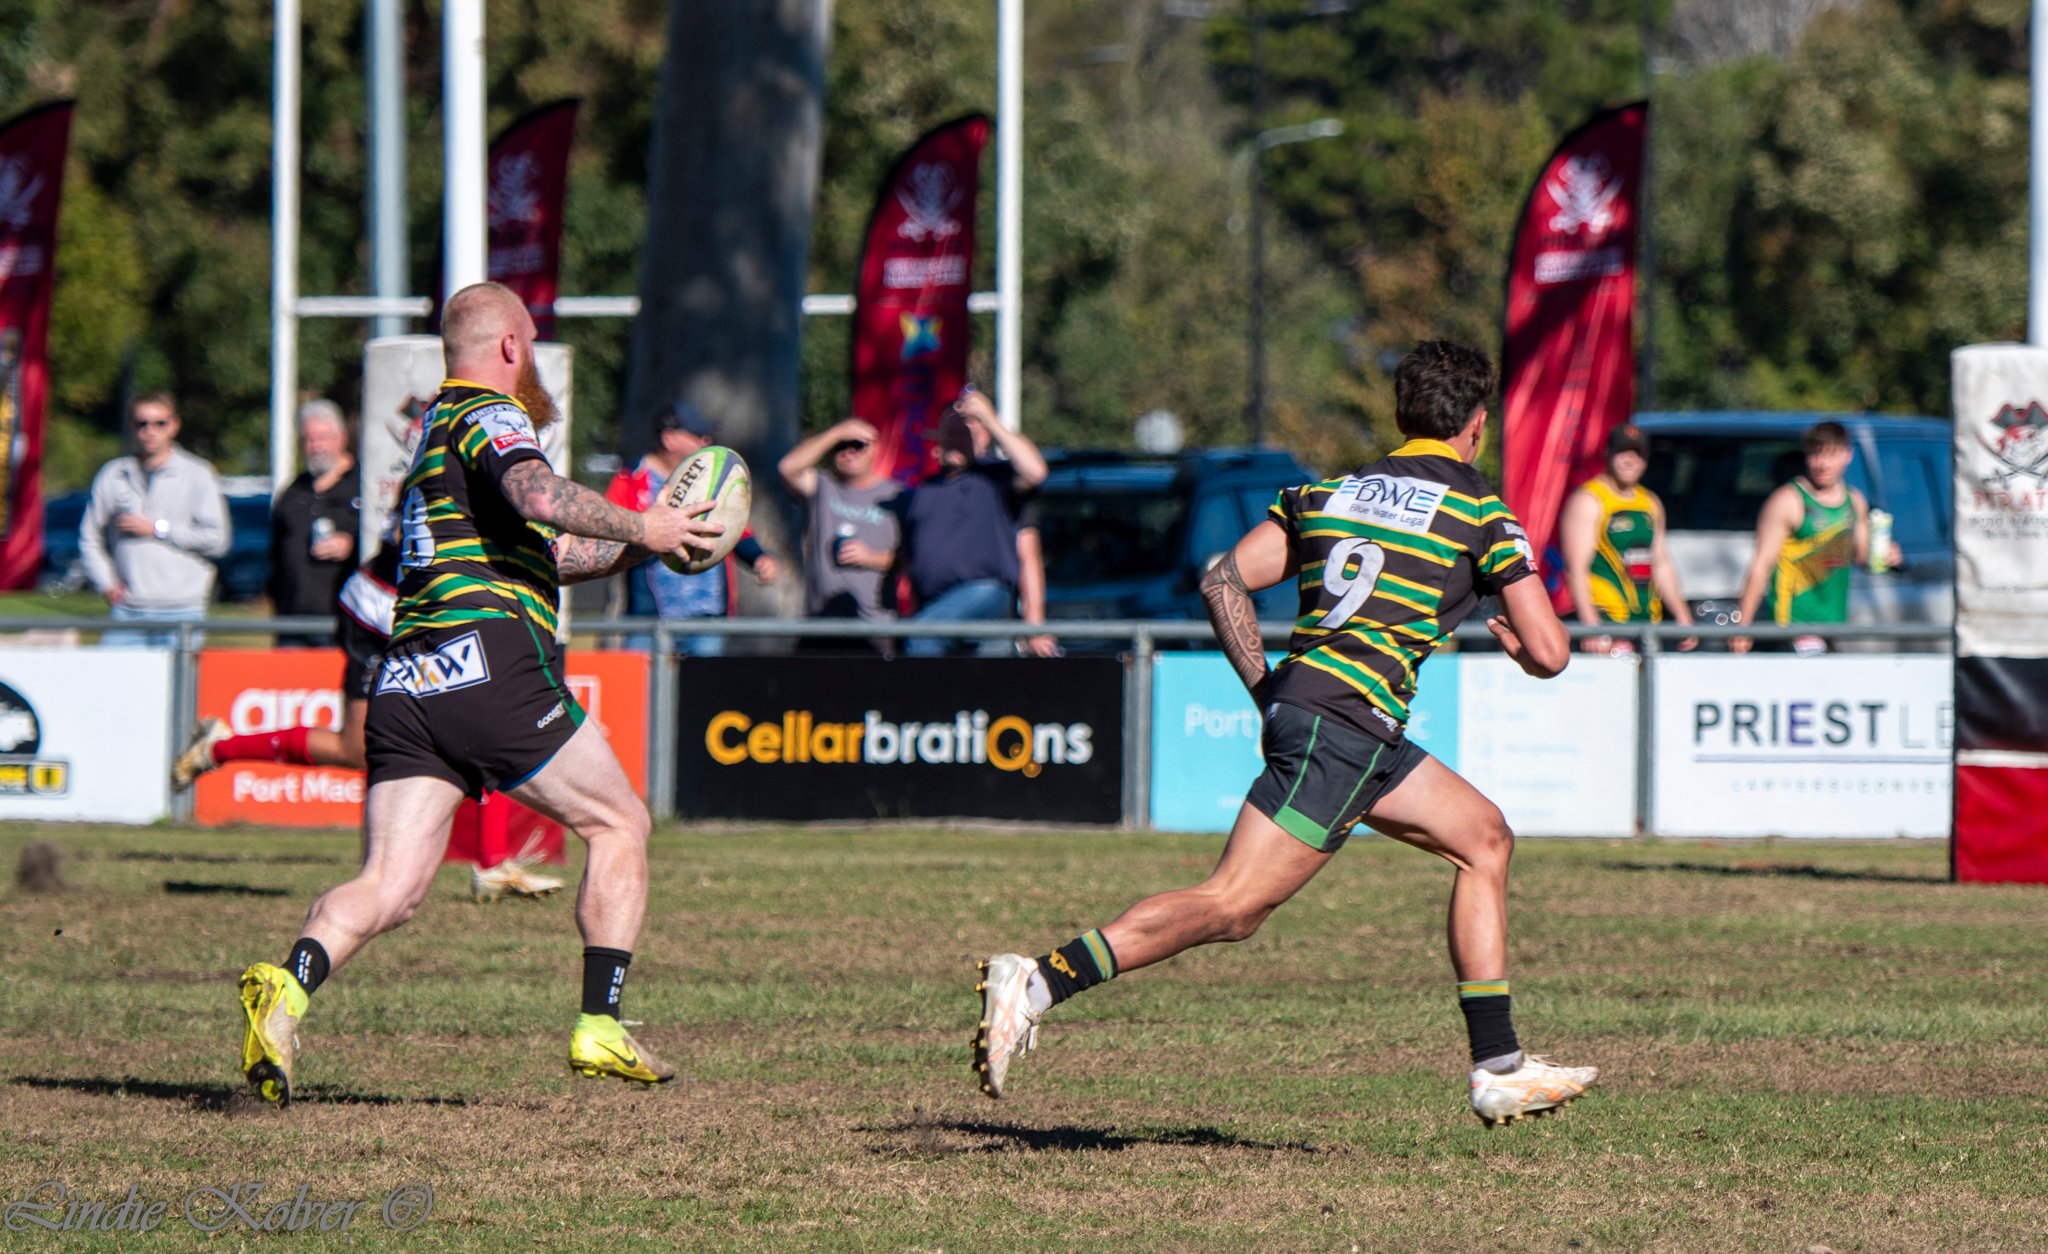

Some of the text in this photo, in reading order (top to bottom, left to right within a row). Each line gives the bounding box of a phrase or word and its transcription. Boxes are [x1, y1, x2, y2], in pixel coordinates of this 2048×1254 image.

[1350, 502, 1426, 527] Blue Water Legal
[1316, 537, 1385, 629] 9
[1184, 702, 1254, 738] Port
[1693, 702, 1888, 746] PRIEST
[705, 710, 1094, 771] Cellarbrations
[233, 772, 299, 803] Port
